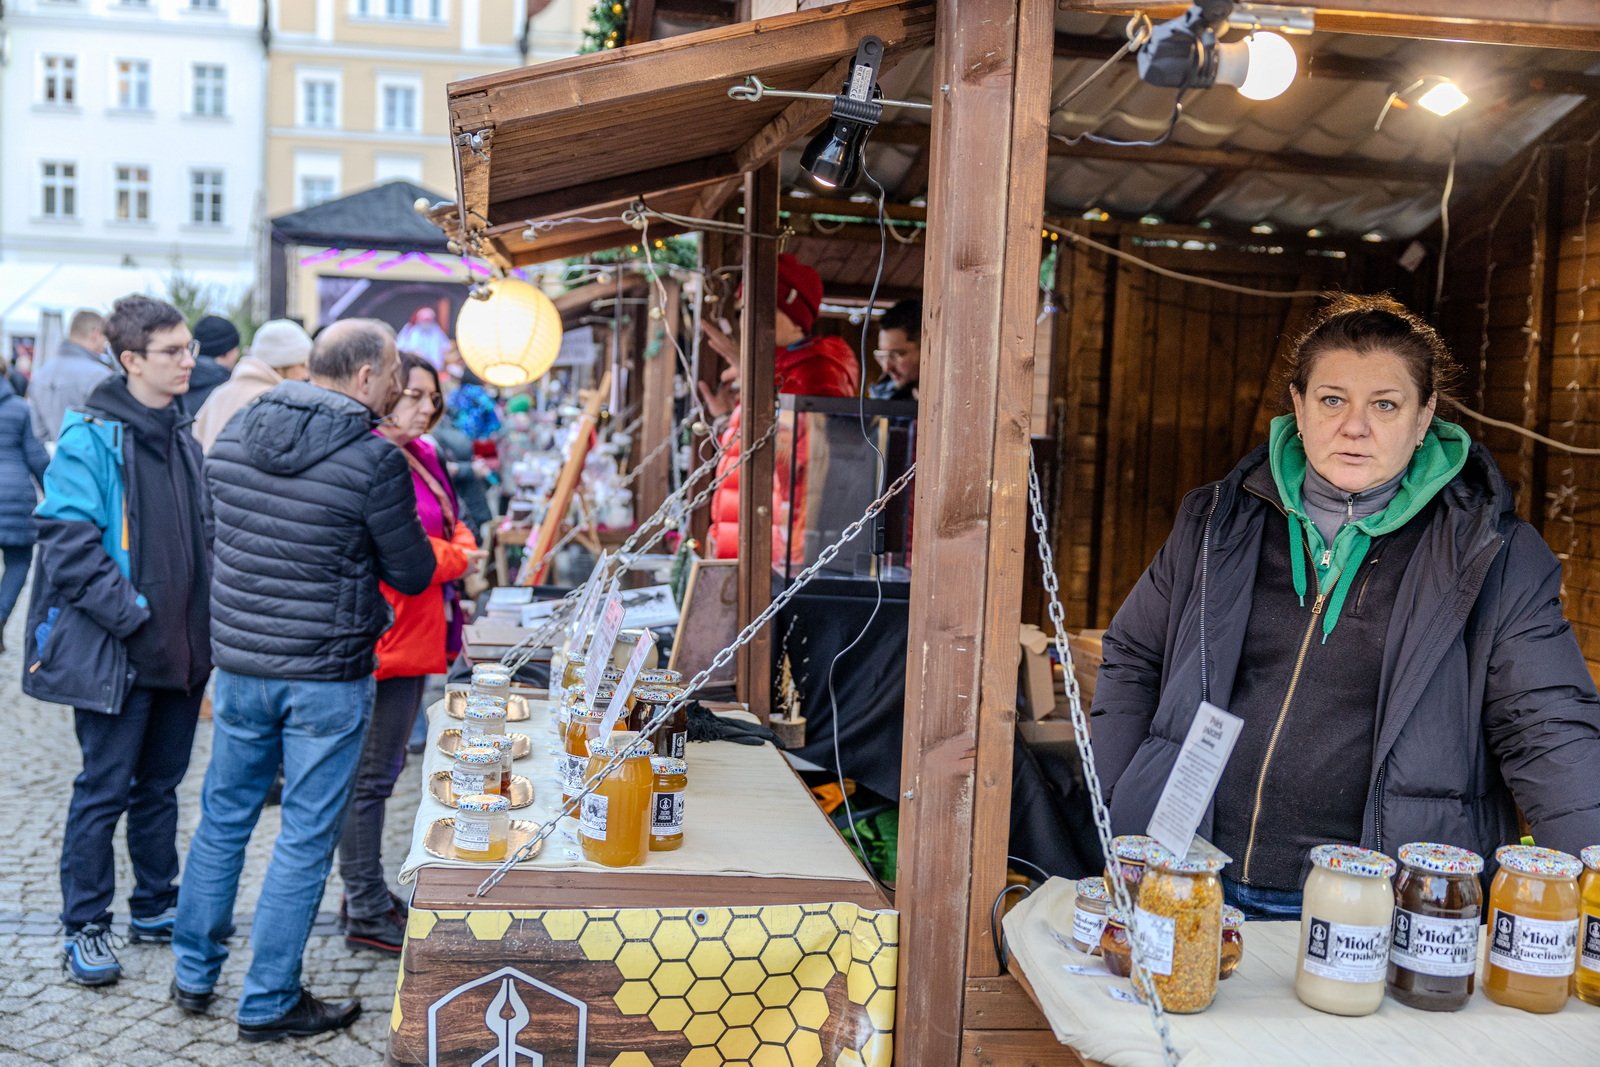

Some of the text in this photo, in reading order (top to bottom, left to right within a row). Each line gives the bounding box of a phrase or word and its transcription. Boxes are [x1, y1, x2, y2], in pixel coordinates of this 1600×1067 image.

[1336, 935, 1374, 950] Miód
[1417, 928, 1455, 944] Miód
[1522, 930, 1558, 945] Miód
